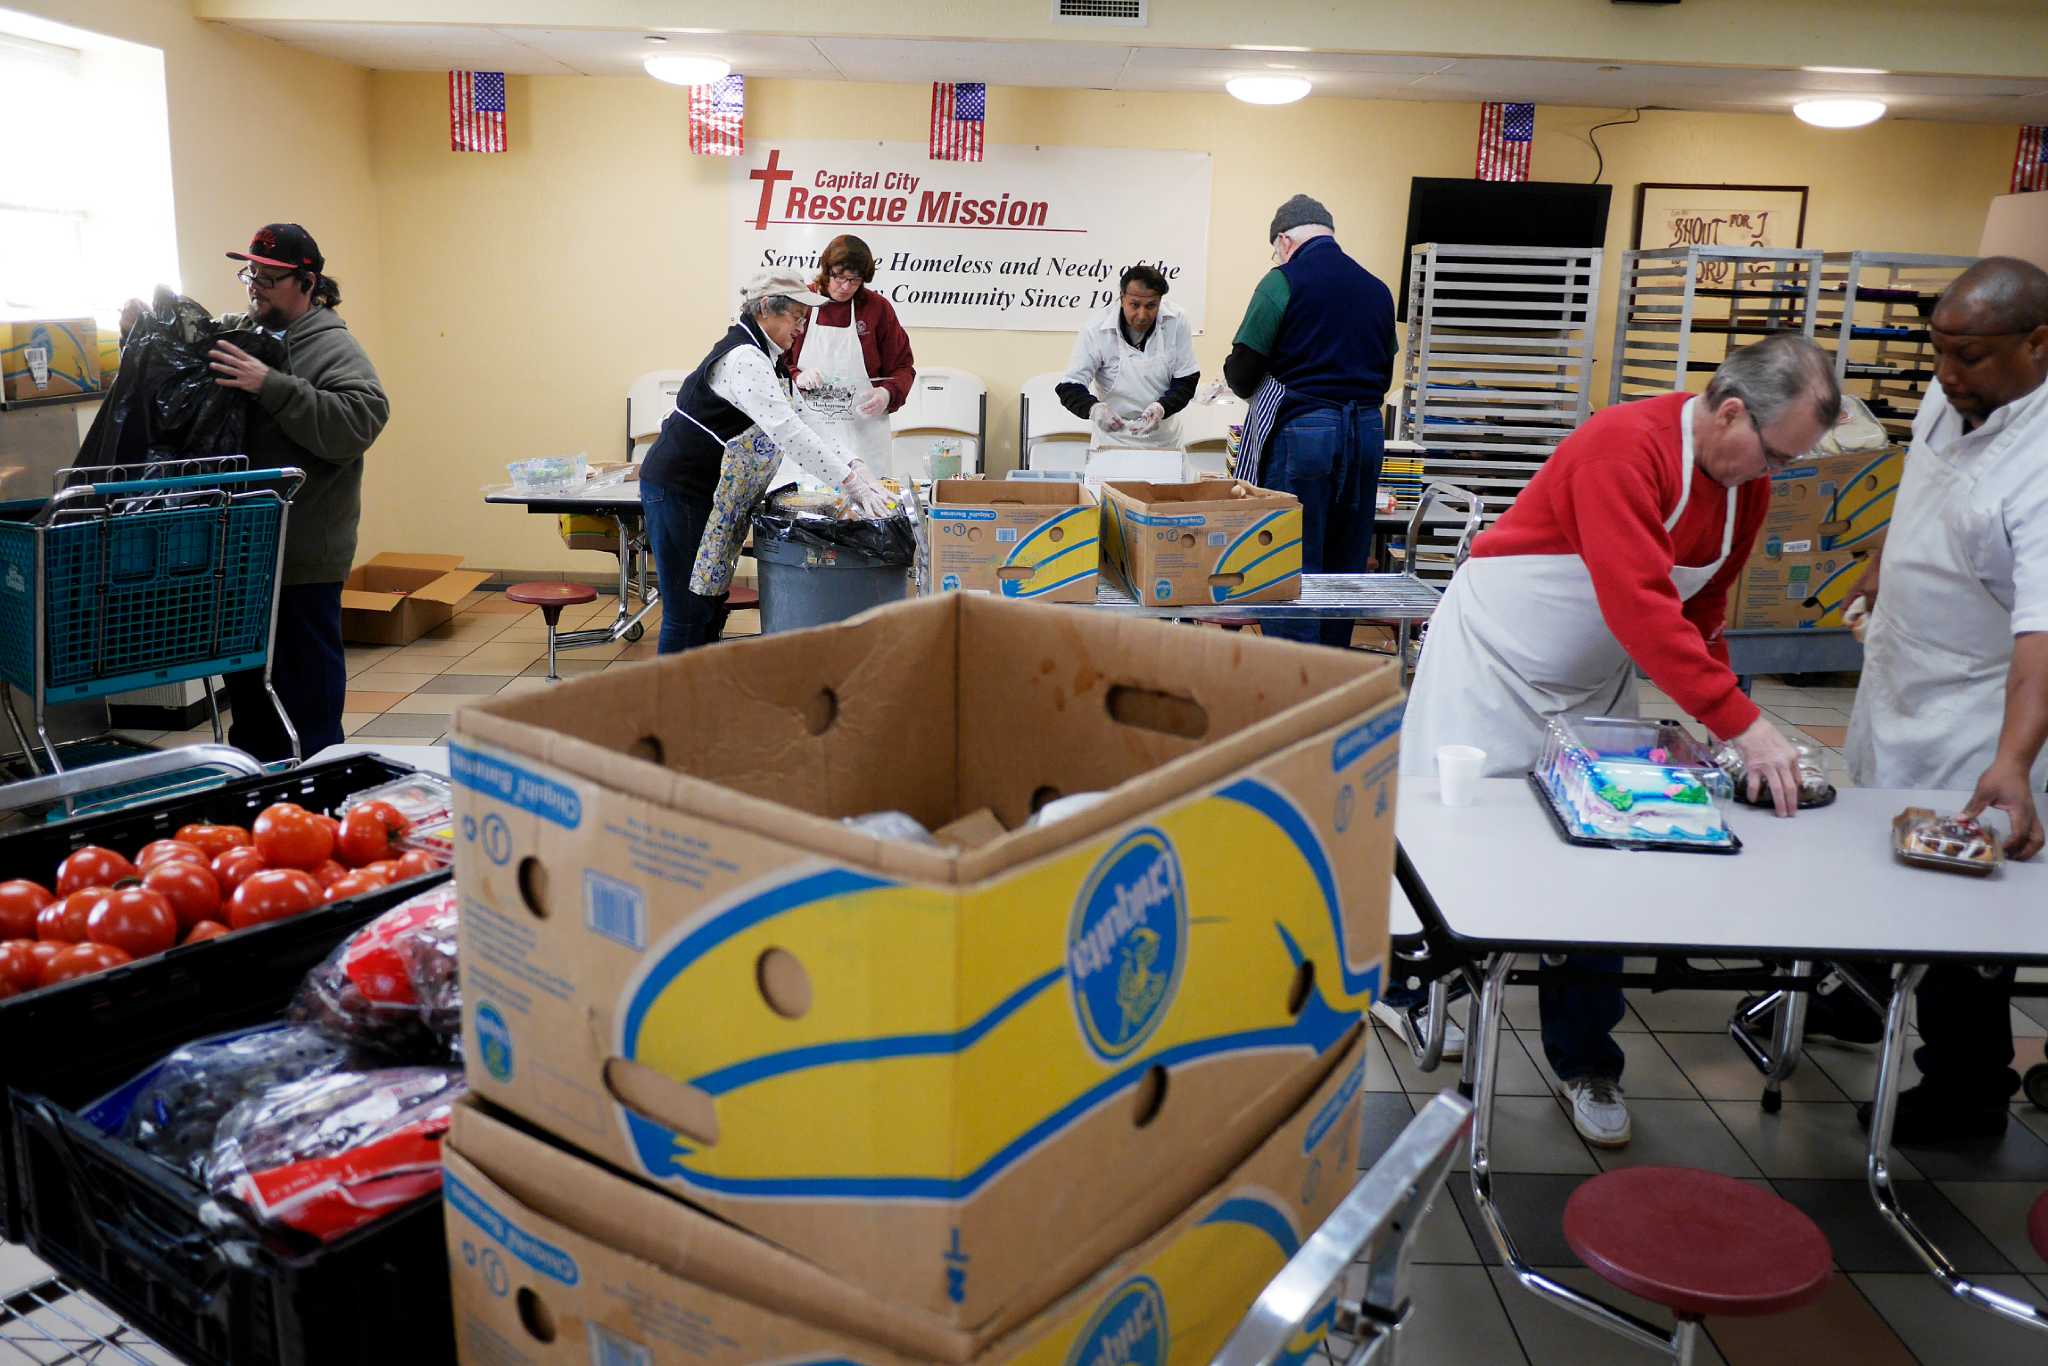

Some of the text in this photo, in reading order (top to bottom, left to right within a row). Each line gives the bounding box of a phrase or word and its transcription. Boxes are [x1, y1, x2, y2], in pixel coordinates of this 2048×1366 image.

[814, 169, 921, 195] Capital City
[784, 186, 1050, 227] Rescue Mission
[1728, 213, 1754, 230] FOR
[760, 248, 822, 270] Servi
[889, 251, 994, 275] Homeless
[999, 256, 1043, 276] and
[1046, 256, 1114, 283] Needy
[891, 283, 1016, 312] Community
[1020, 287, 1081, 309] Since
